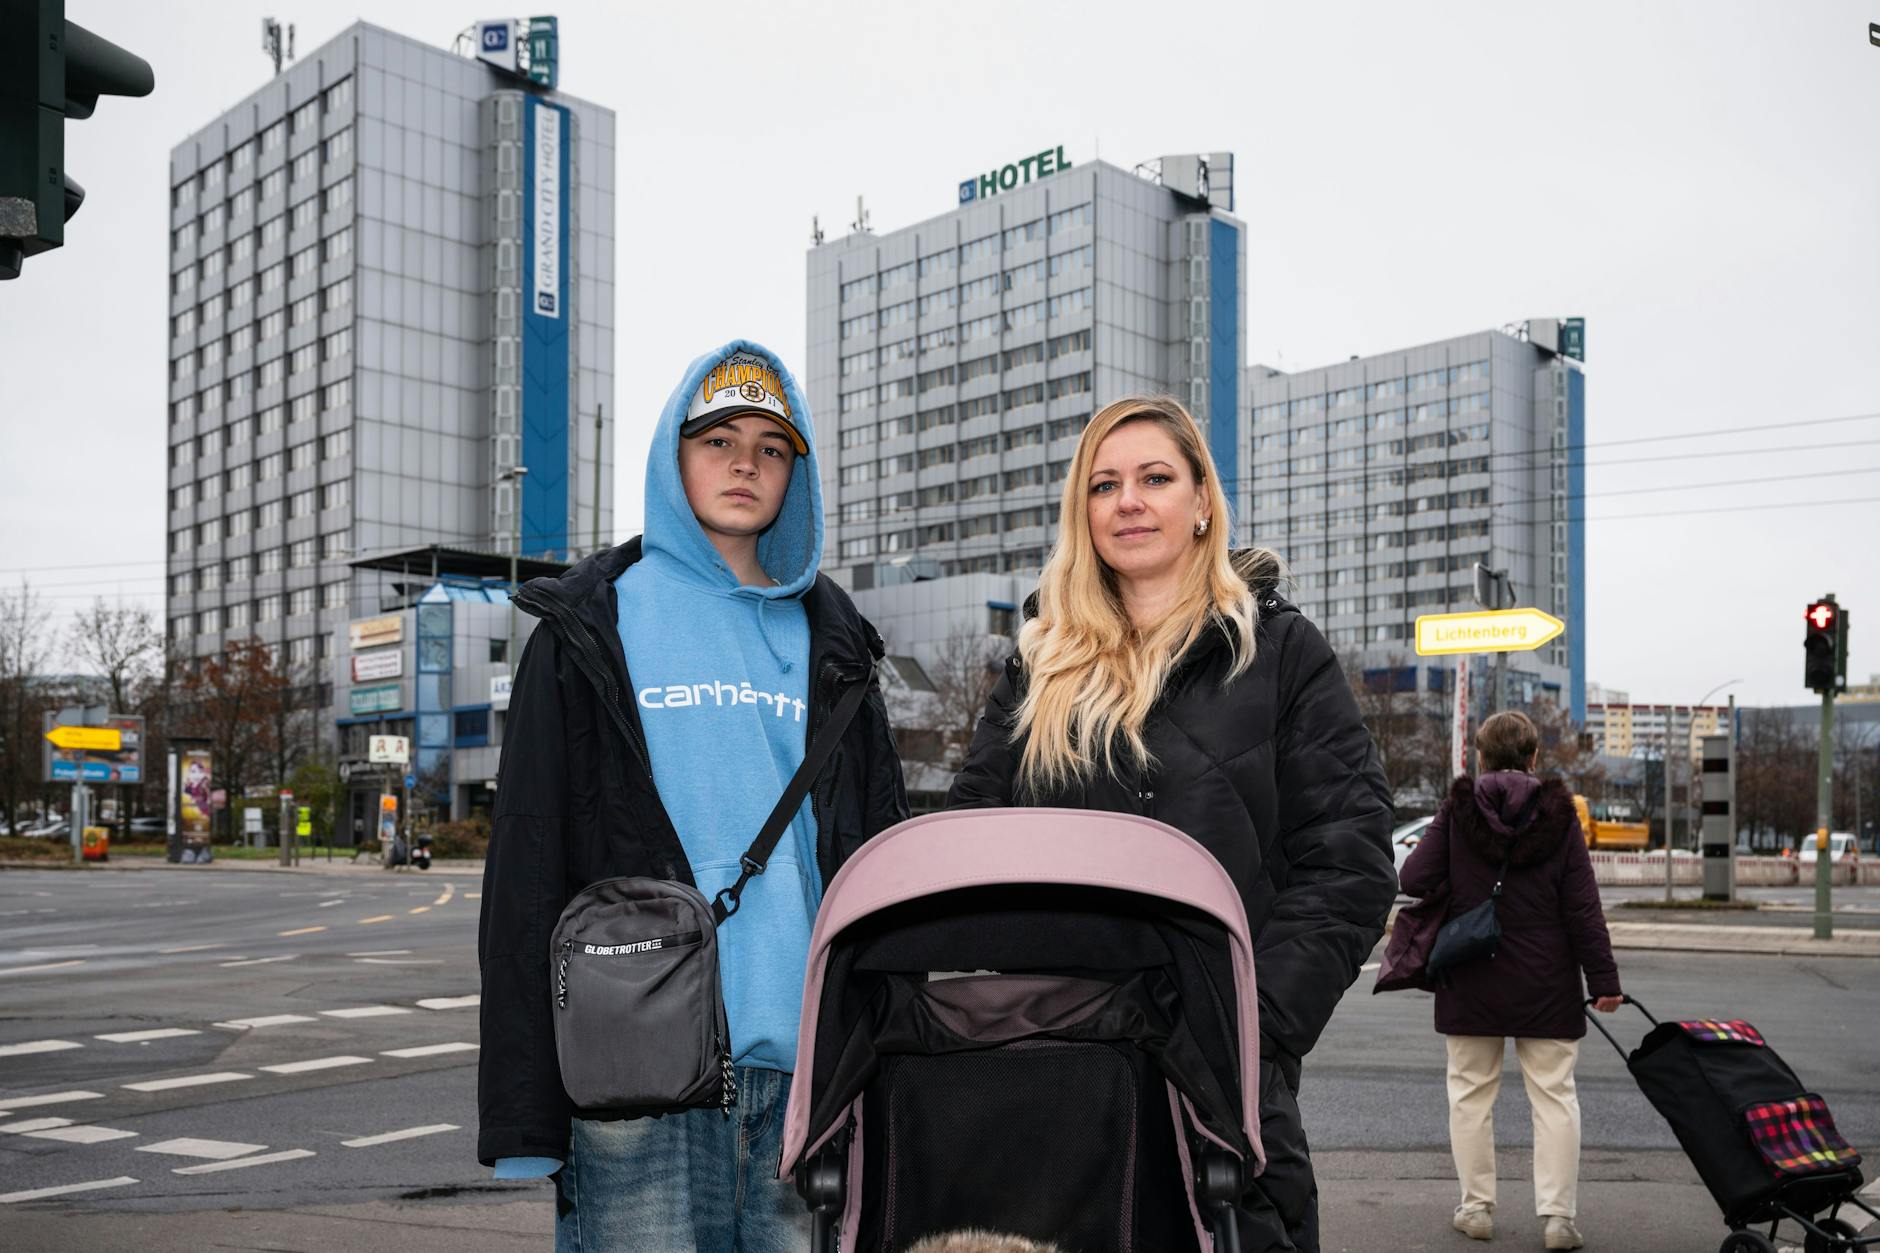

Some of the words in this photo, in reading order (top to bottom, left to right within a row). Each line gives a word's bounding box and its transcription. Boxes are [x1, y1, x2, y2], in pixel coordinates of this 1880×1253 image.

[542, 112, 555, 169] HOTEL
[980, 145, 1072, 200] HOTEL
[542, 172, 554, 217] CITY
[541, 220, 554, 288] GRAND
[733, 356, 765, 371] Stanley
[724, 389, 737, 398] 20
[1436, 625, 1528, 642] Lichtenberg
[638, 680, 806, 722] carhartt
[584, 940, 652, 956] GLOBETROTTER
